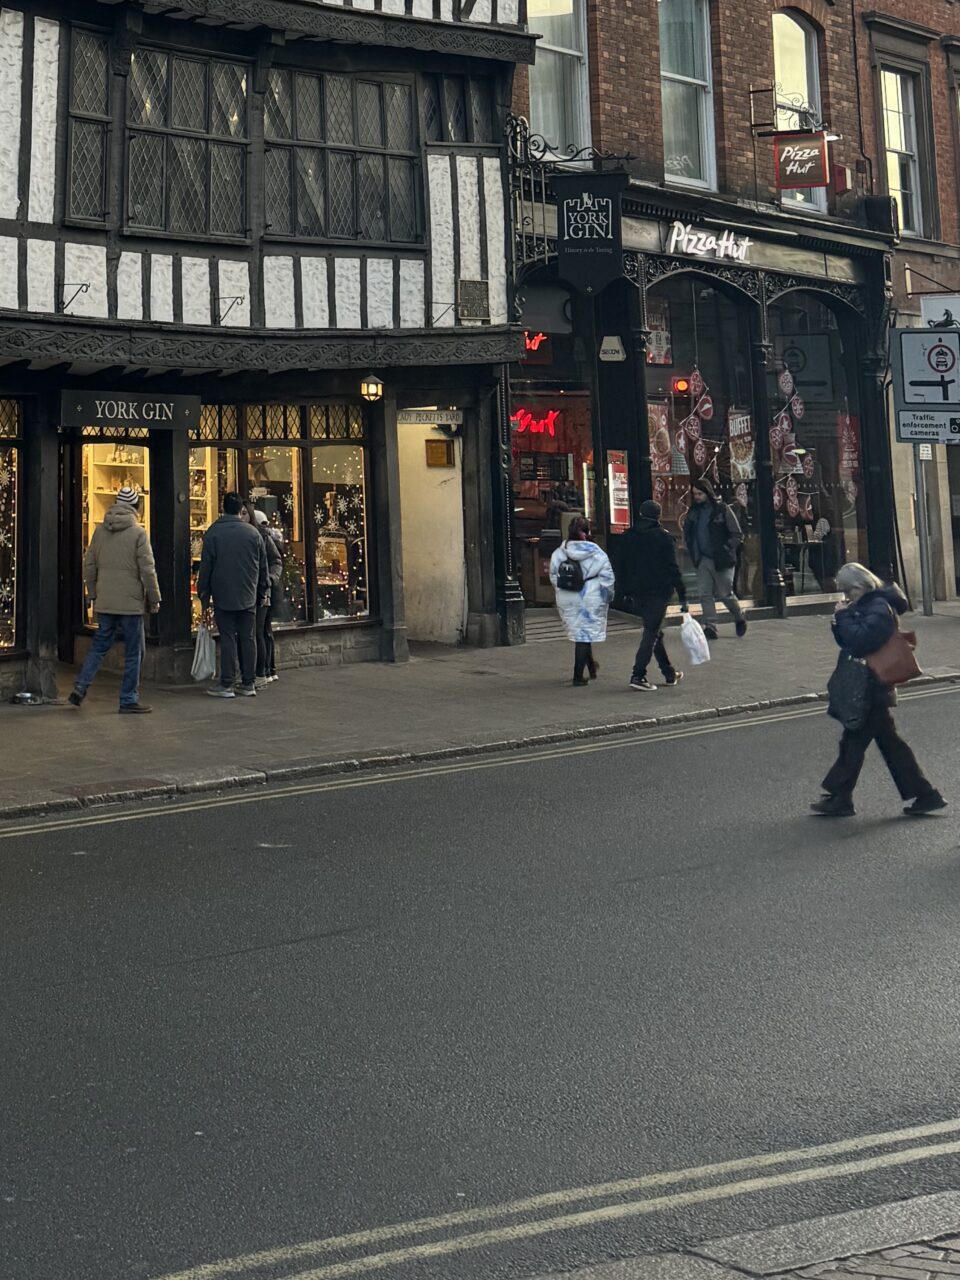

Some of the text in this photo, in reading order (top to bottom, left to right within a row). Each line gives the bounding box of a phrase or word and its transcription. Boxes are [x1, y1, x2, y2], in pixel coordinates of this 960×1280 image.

[780, 146, 820, 162] Pizza
[785, 161, 816, 175] Hut
[568, 212, 608, 224] YORK
[569, 223, 607, 238] GIN
[670, 221, 754, 260] Pizza Hut
[524, 331, 547, 351] ut
[95, 400, 174, 420] YORK GIN
[729, 415, 751, 436] BUFFET
